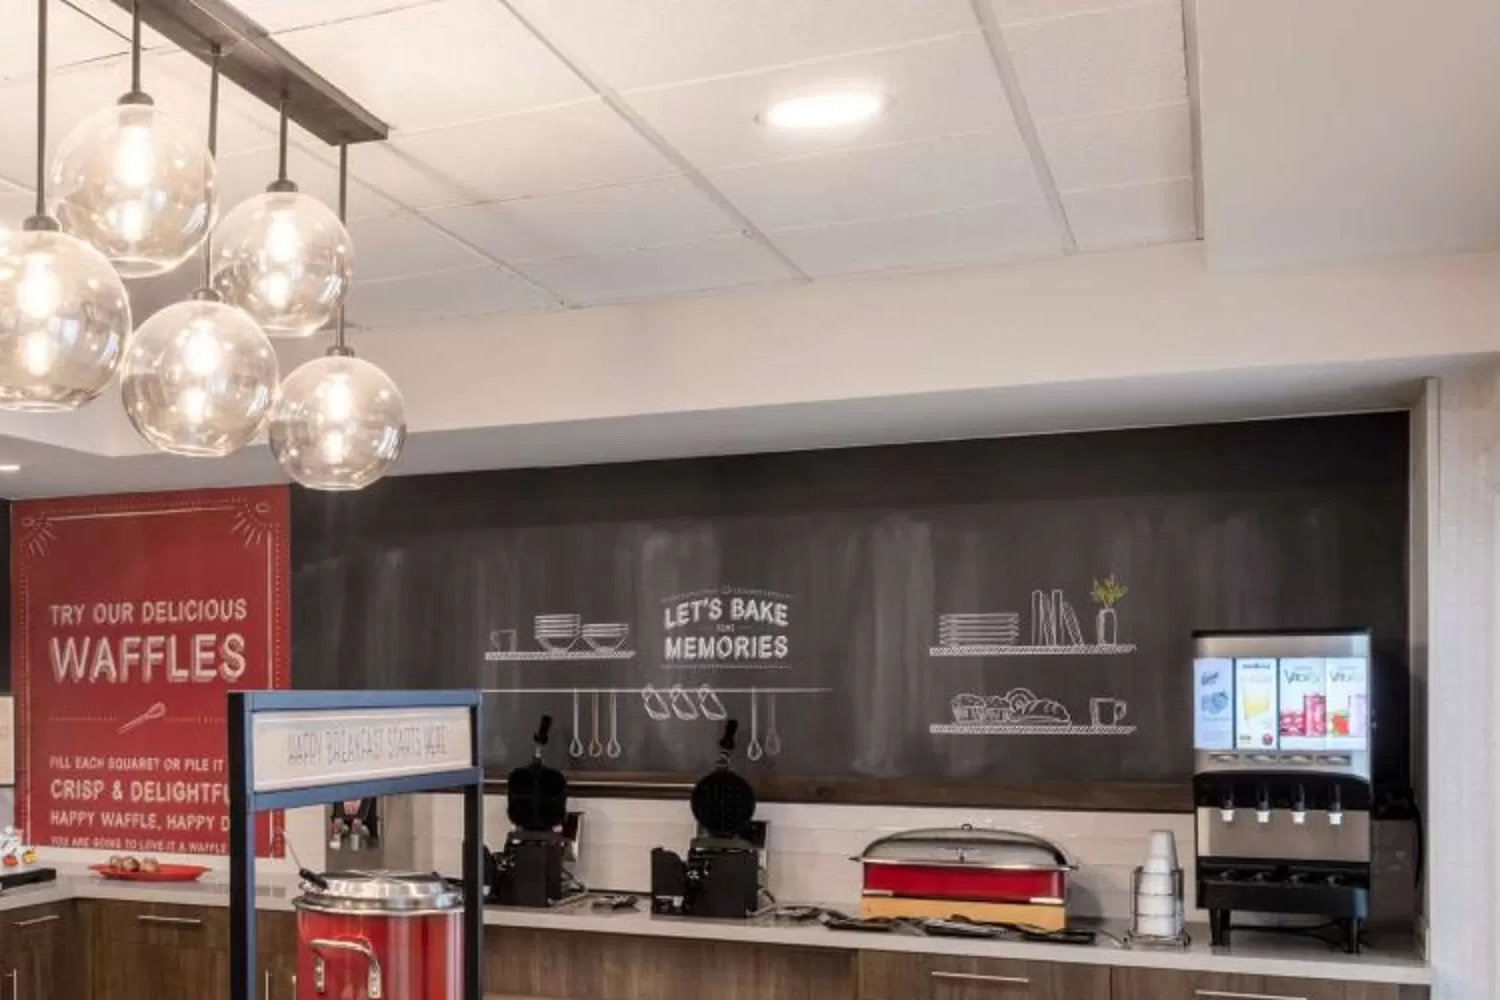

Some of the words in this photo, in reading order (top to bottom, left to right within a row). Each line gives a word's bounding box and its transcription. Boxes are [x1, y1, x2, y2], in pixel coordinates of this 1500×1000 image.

[50, 604, 85, 626] TRY
[93, 602, 134, 624] OUR
[143, 599, 248, 624] DELICIOUS
[664, 598, 723, 630] LET'S
[730, 598, 789, 628] BAKE
[50, 633, 247, 684] WAFFLES
[664, 635, 789, 660] MEMORIES
[50, 755, 72, 769] FILL
[75, 756, 105, 770] EACH
[163, 758, 181, 771] OR
[184, 758, 209, 771] PILE
[213, 759, 223, 771] IT
[50, 779, 105, 800] CRISP
[111, 780, 123, 801] &
[50, 810, 95, 828] HAPPY
[101, 811, 162, 831] WAFFLE,
[167, 814, 215, 832] HAPPY
